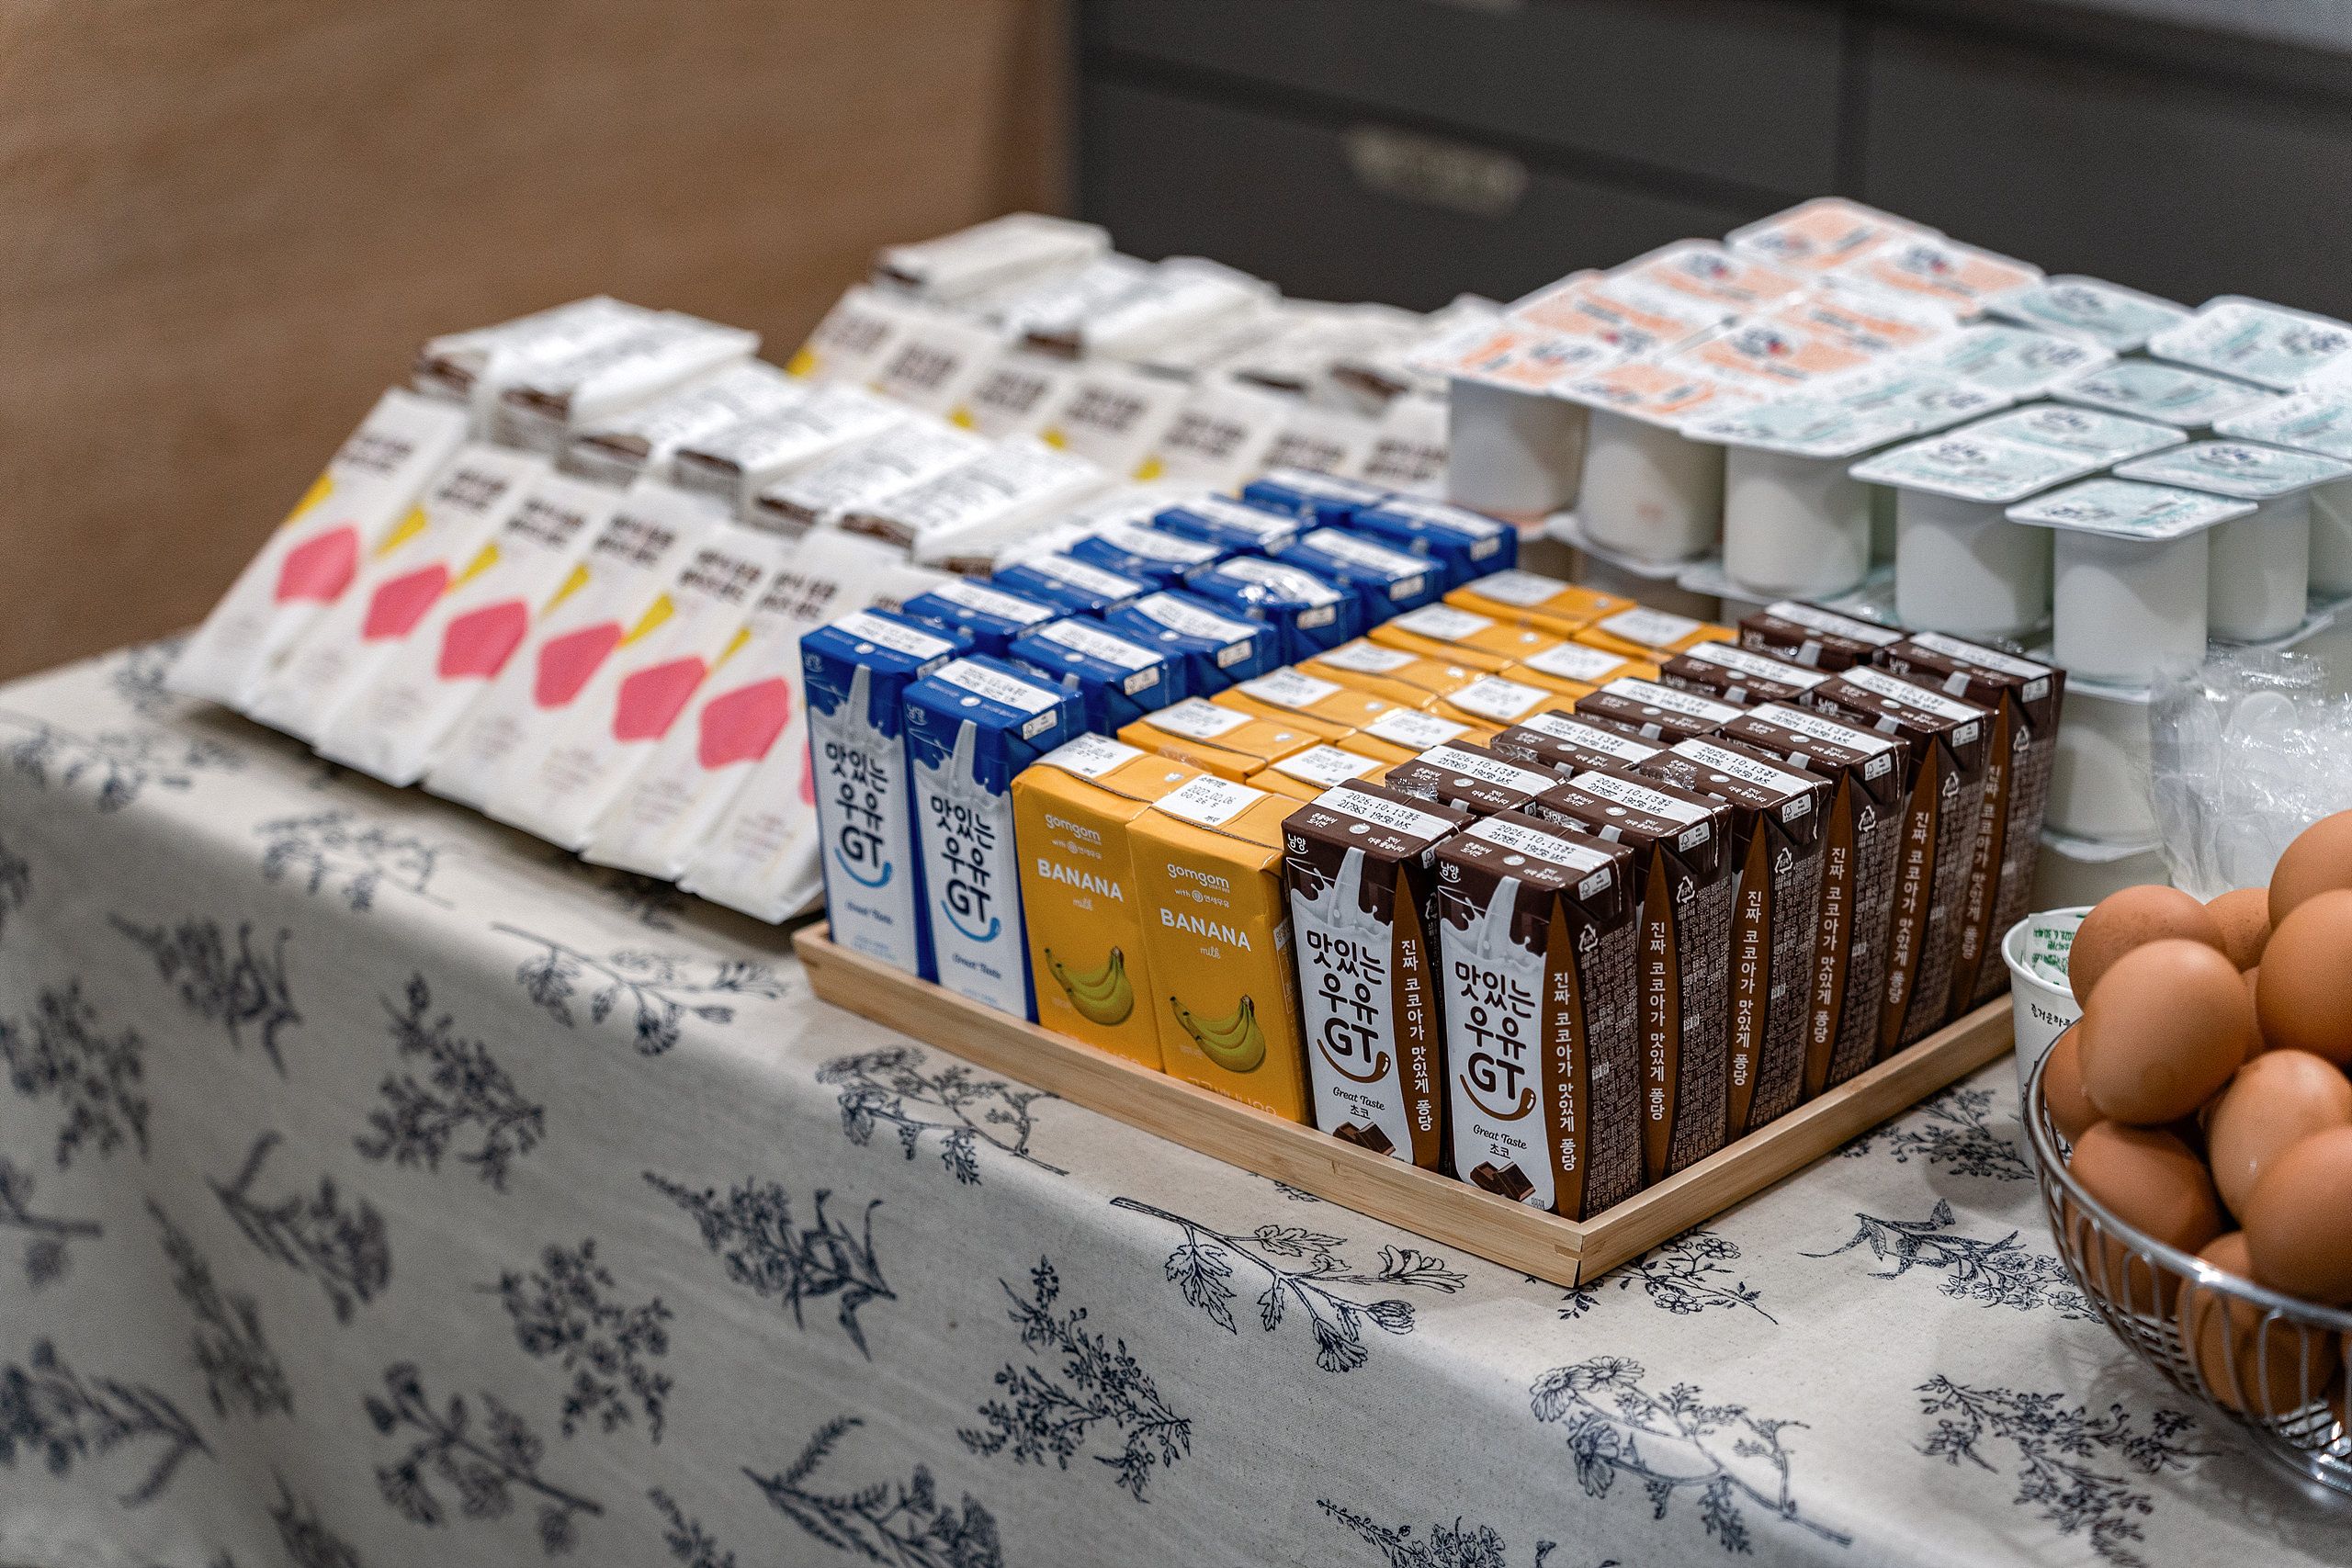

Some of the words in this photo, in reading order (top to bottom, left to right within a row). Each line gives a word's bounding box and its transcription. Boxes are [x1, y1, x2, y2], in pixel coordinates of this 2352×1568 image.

[826, 741, 888, 795] 맛있는
[835, 783, 883, 831] 우유
[930, 795, 996, 851] 맛있는
[1045, 814, 1102, 840] gomgom
[1911, 811, 1929, 846] 진짜
[840, 826, 884, 868] GT
[941, 837, 990, 887] 우유
[1287, 833, 1306, 852] 남양
[1828, 847, 1846, 881] 진짜
[1037, 858, 1124, 903] BANANA
[1167, 863, 1229, 888] gomgom
[1174, 888, 1191, 897] with
[1440, 861, 1460, 880] 남양
[1901, 849, 1924, 914] 코코아가
[946, 878, 991, 924] GT
[1746, 890, 1761, 923] 진짜
[1822, 886, 1842, 953] 코코아가
[1159, 908, 1251, 953] BANANA
[1200, 945, 1221, 960] milk
[1649, 921, 1666, 955] 진짜
[1893, 917, 1912, 966] 맛있게
[1306, 930, 1385, 986] 맛있는
[1401, 939, 1419, 972] 진짜
[1739, 930, 1759, 995] 코코아가
[1318, 973, 1379, 1026] 우유
[1454, 960, 1536, 1020] 맛있는
[1554, 972, 1571, 1006] 진짜
[1649, 962, 1666, 1027] 코코아가
[1816, 955, 1837, 1006] 맛있게
[1405, 977, 1425, 1042] 코코아가
[1736, 999, 1754, 1048] 맛있게
[1813, 1010, 1830, 1043] 퐁당
[1324, 1017, 1379, 1064] GT
[1464, 1005, 1527, 1060] 우유
[1555, 1011, 1573, 1077] 코코아가
[1411, 1045, 1430, 1095] 맛있게
[1467, 1052, 1525, 1100] GT
[1650, 1032, 1666, 1082] 맛있게
[1732, 1053, 1748, 1087] 퐁당
[1332, 1086, 1359, 1103] Great
[1360, 1095, 1385, 1111] Taste
[1350, 1104, 1371, 1120] 초코
[1415, 1099, 1433, 1133] 퐁당
[1557, 1082, 1575, 1133] 맛있게
[1649, 1087, 1666, 1121] 퐁당
[1473, 1123, 1499, 1141] Great
[1500, 1133, 1528, 1150] Taste
[1489, 1143, 1511, 1159] 초코
[1560, 1137, 1577, 1171] 퐁당
